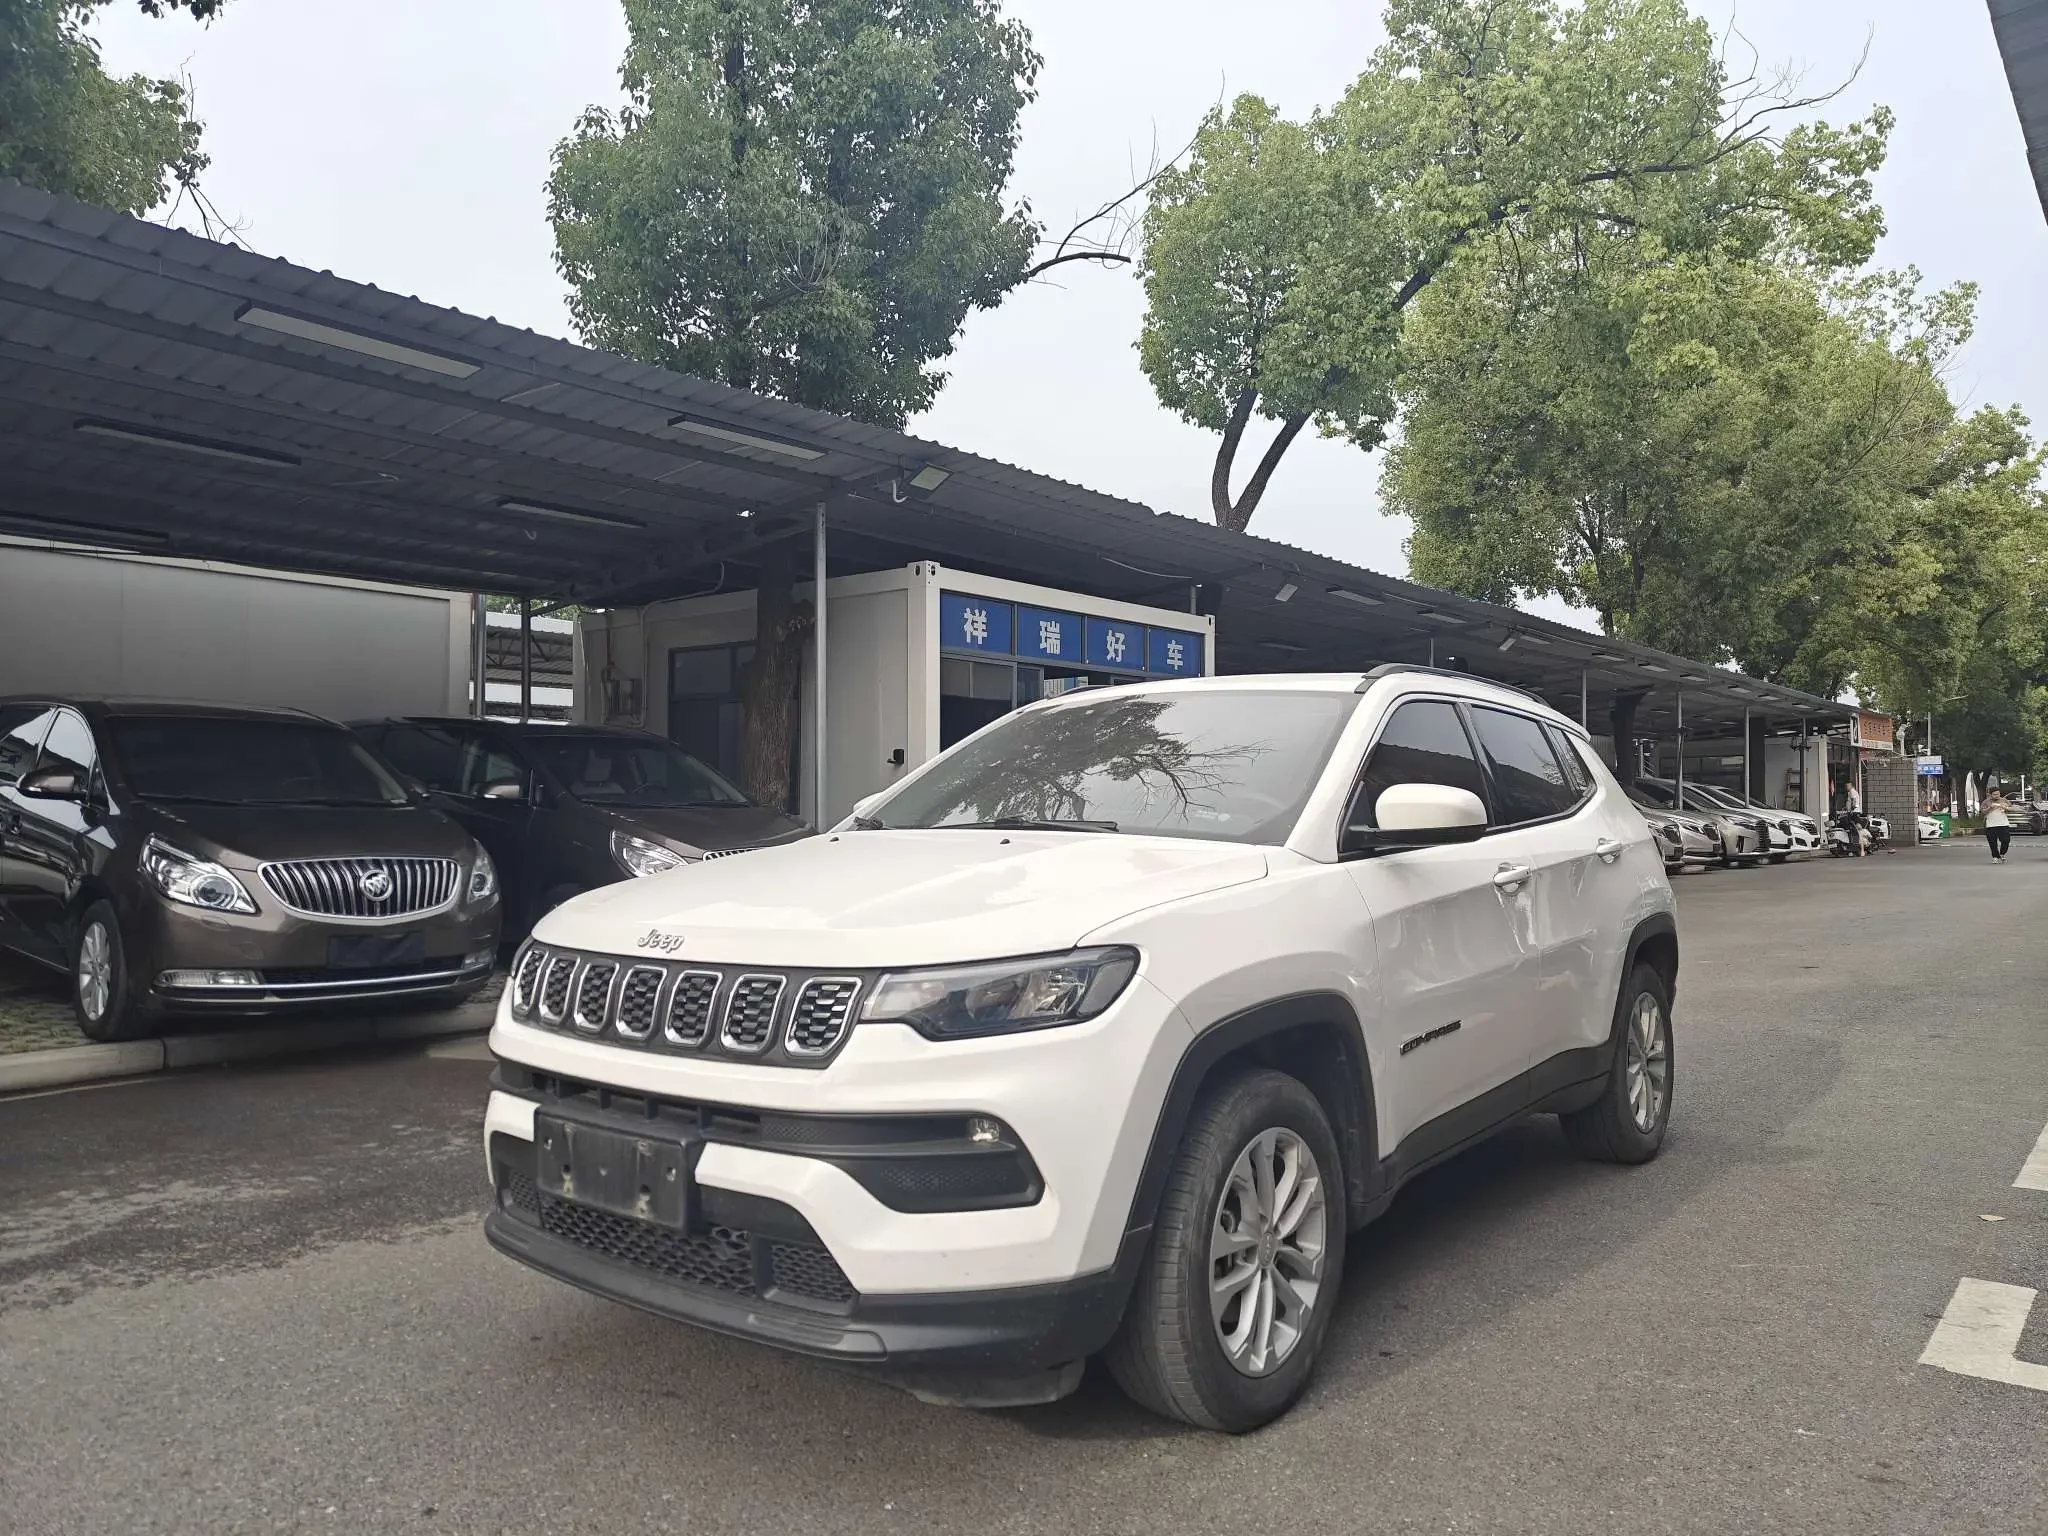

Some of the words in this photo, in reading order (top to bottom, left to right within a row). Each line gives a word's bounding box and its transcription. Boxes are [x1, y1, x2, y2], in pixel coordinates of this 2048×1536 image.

[963, 607, 1184, 670] 祥瑞好车
[637, 928, 684, 954] Jeep
